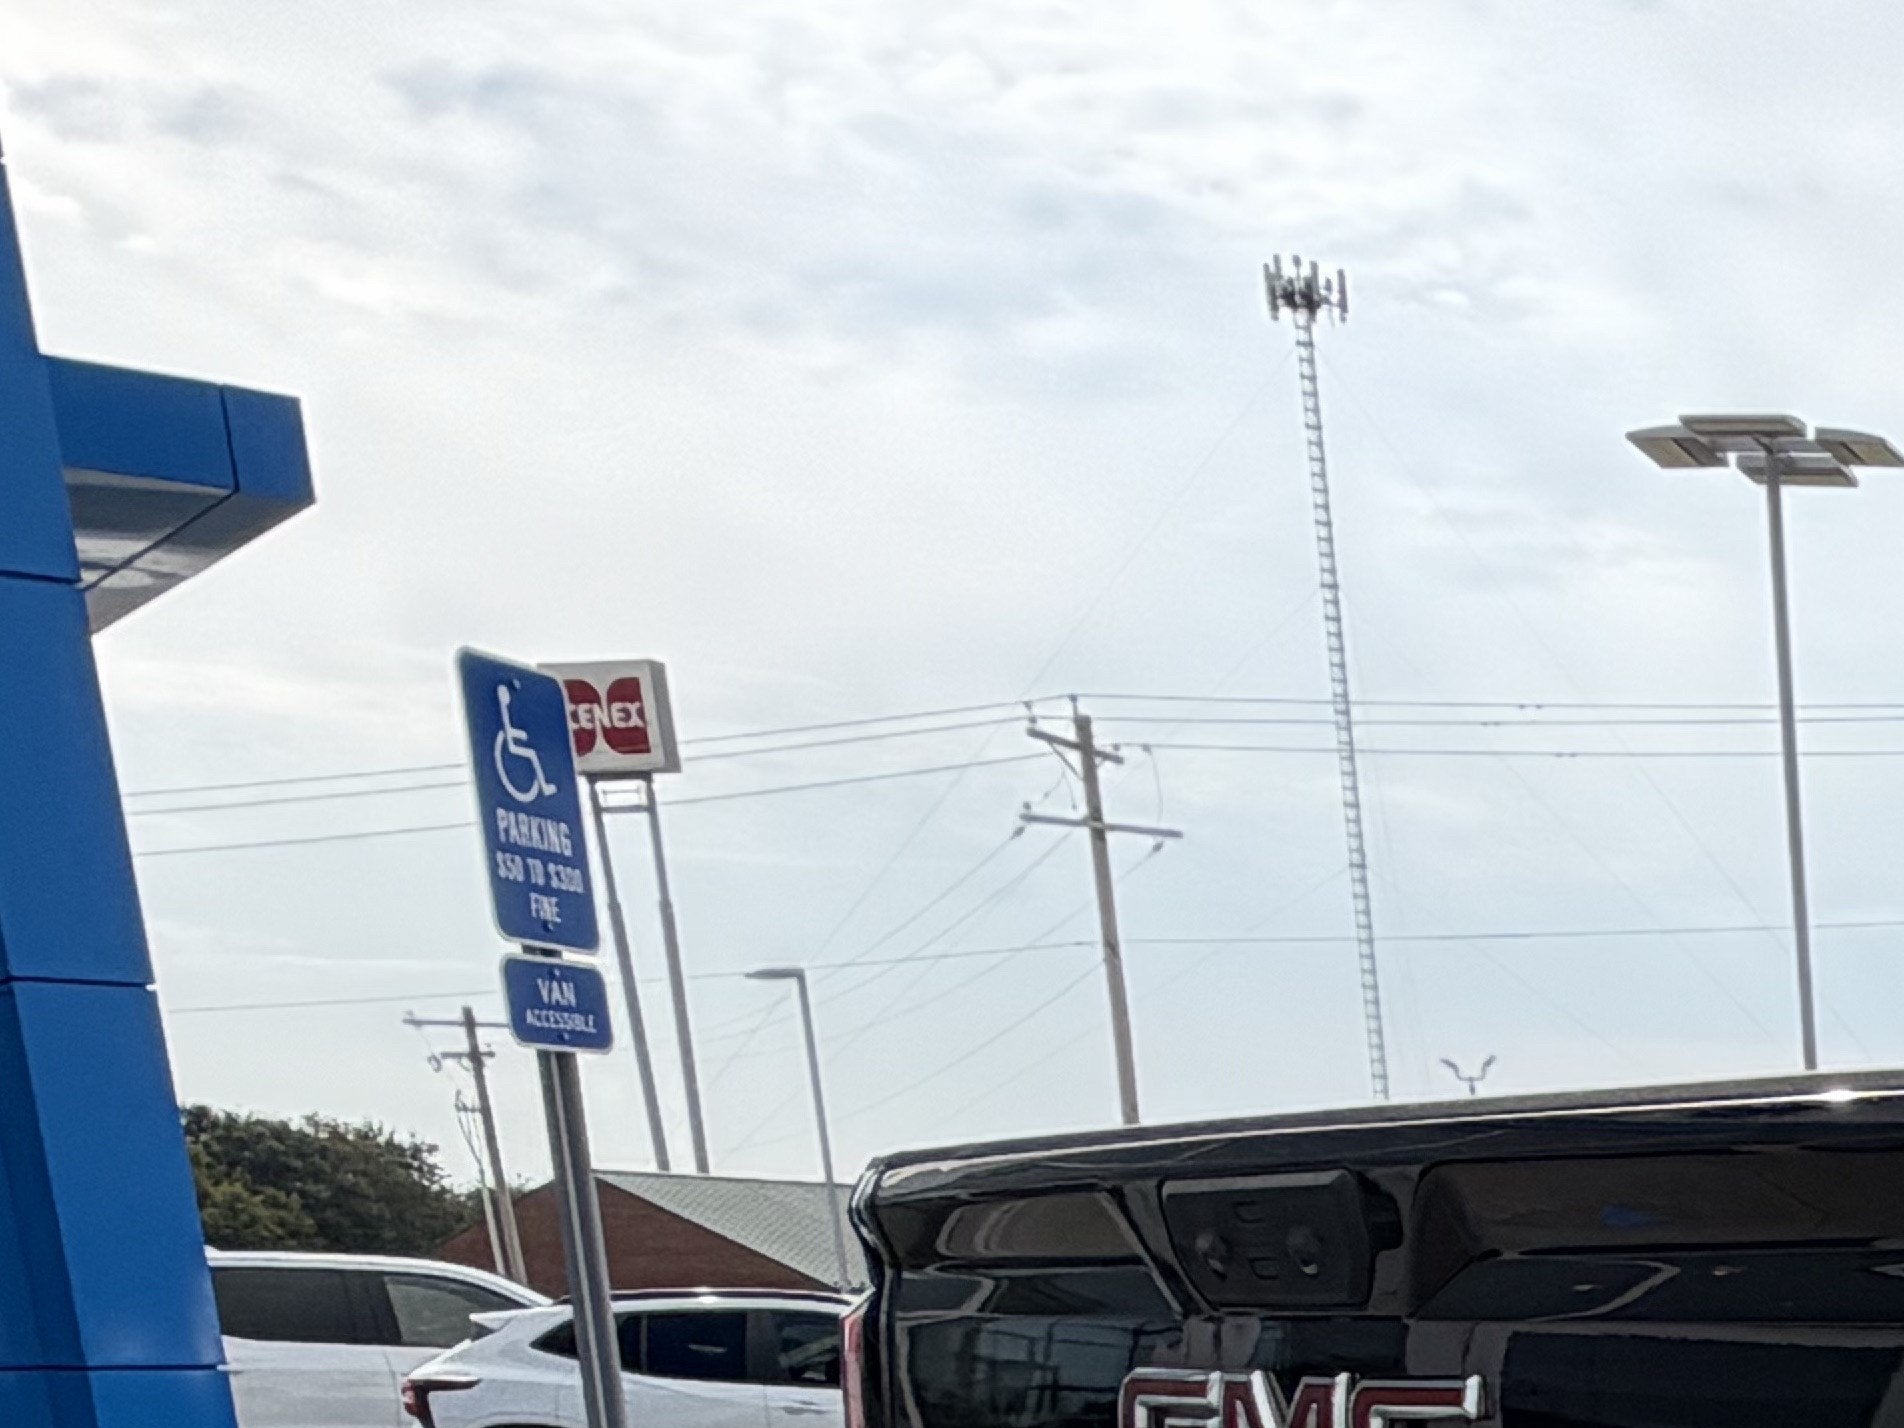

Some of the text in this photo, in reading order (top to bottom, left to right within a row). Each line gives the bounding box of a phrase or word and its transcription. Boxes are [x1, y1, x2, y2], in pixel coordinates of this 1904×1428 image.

[496, 806, 573, 857] PARKING
[496, 850, 525, 882] $50
[526, 857, 546, 886] TO
[529, 892, 562, 923] FINE
[536, 978, 577, 1008] VAN
[525, 1008, 598, 1034] ACCESSIBLE
